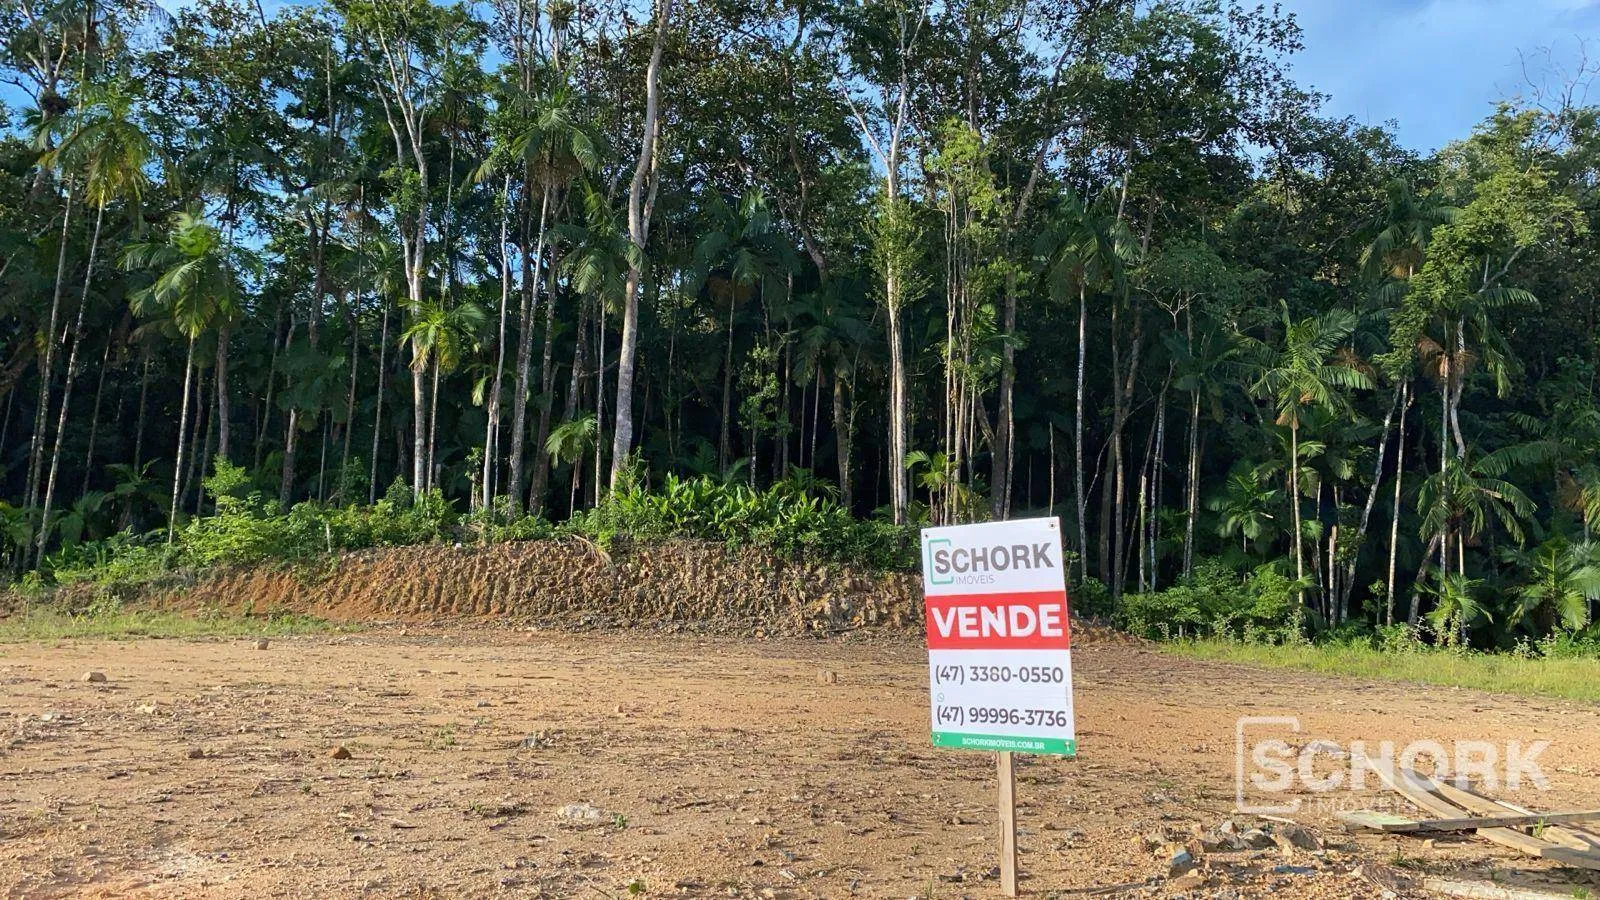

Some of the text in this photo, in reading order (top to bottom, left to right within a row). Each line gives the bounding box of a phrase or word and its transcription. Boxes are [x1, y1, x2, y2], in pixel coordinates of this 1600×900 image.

[934, 543, 1054, 574] SCHORK
[931, 604, 1063, 638] VENDE
[936, 665, 965, 685] (47)
[937, 705, 1067, 727] (47) 99996-3736
